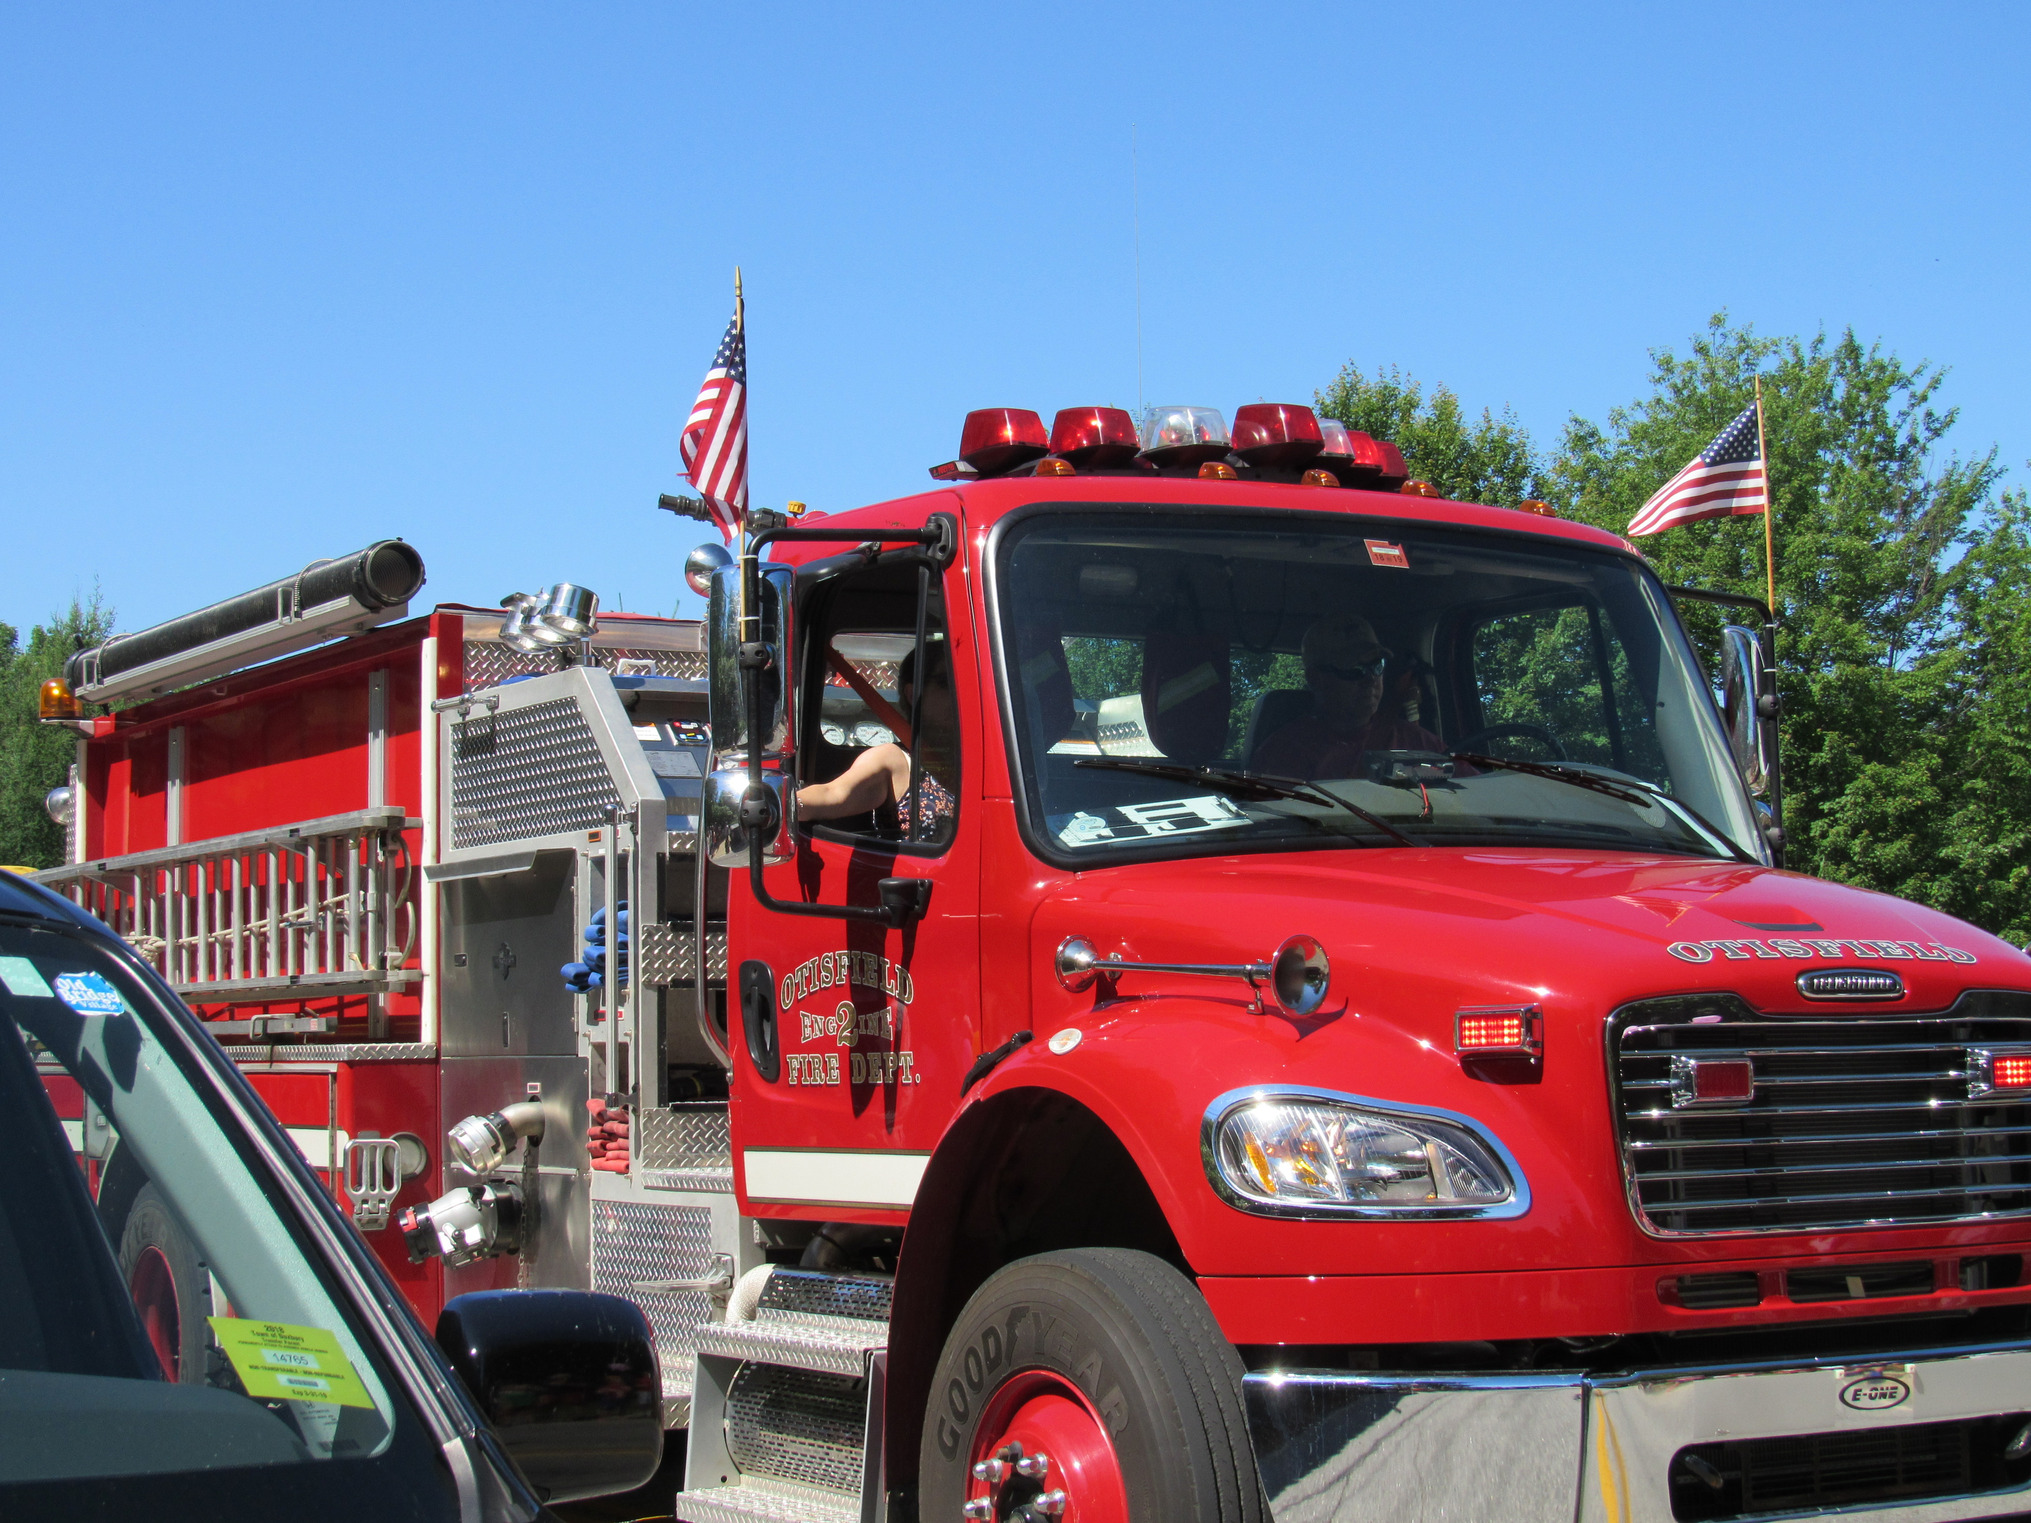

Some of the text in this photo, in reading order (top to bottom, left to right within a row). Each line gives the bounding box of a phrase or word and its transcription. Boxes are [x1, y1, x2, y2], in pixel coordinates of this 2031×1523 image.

[1667, 939, 1977, 963] OTISFIELD
[781, 950, 914, 1010] OTISFIELD
[836, 1000, 859, 1047] 2
[786, 1051, 921, 1085] FIRE DEPT.
[937, 1304, 1129, 1463] GOODYEAR
[1851, 1386, 1899, 1402] E-ONE
